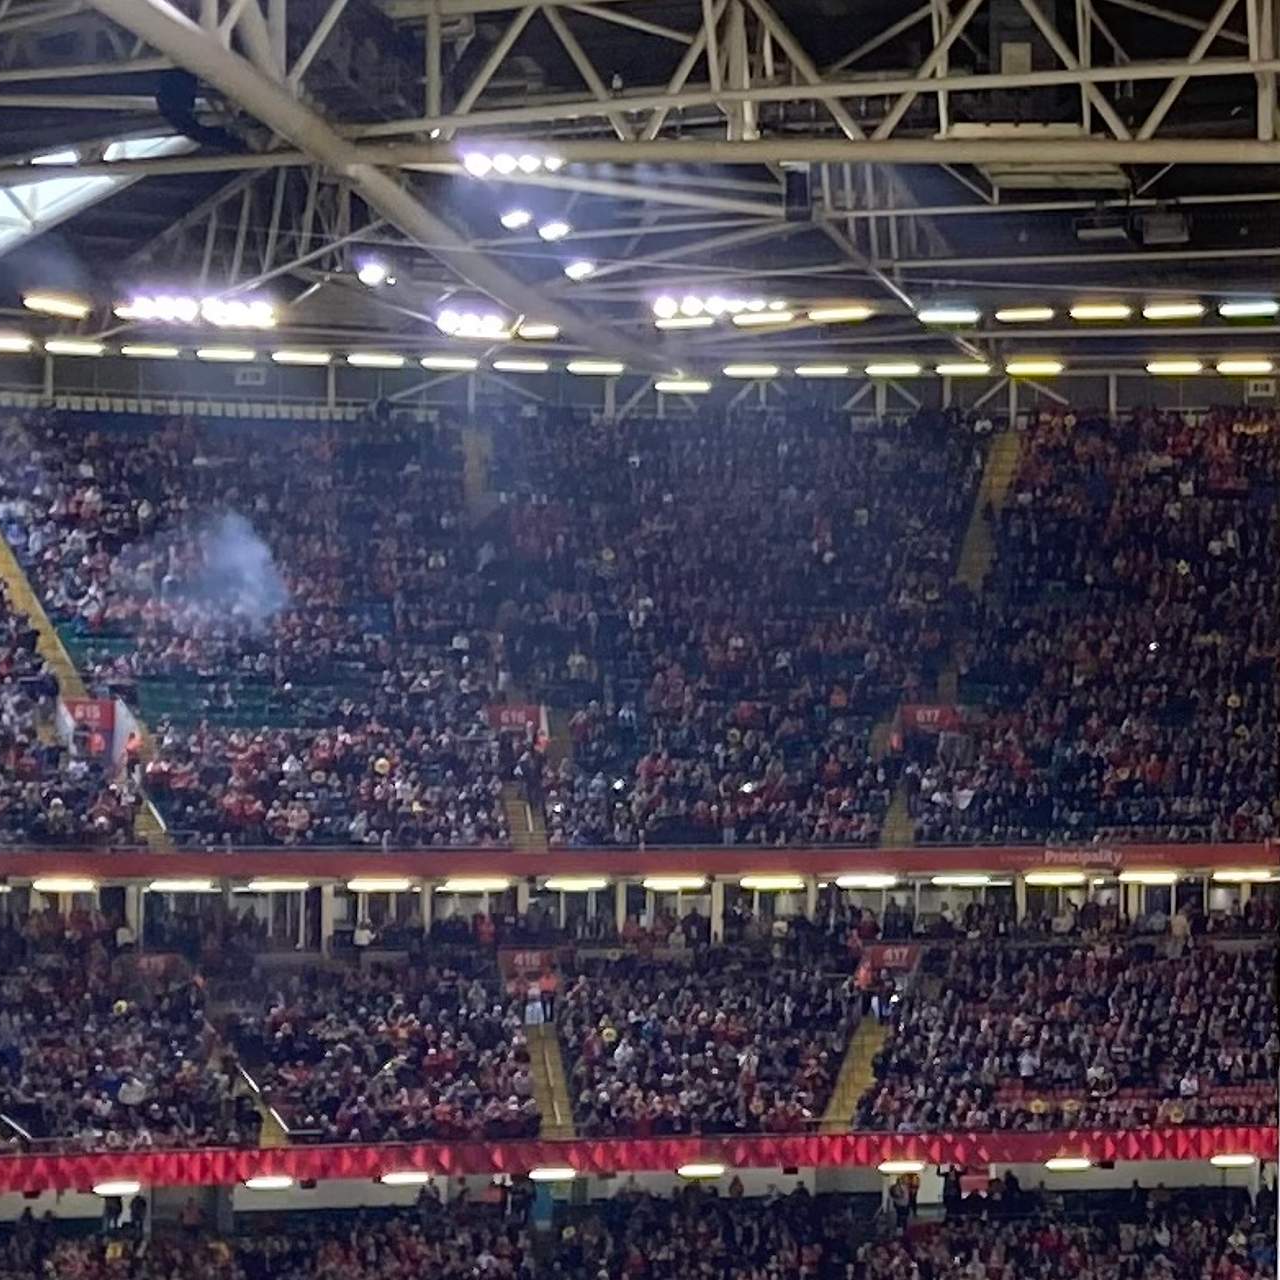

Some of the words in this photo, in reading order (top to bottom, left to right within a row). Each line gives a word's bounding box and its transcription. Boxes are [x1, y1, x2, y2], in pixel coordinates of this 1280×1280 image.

[916, 710, 940, 722] 617
[1044, 849, 1123, 865] Principality
[883, 947, 908, 960] 417
